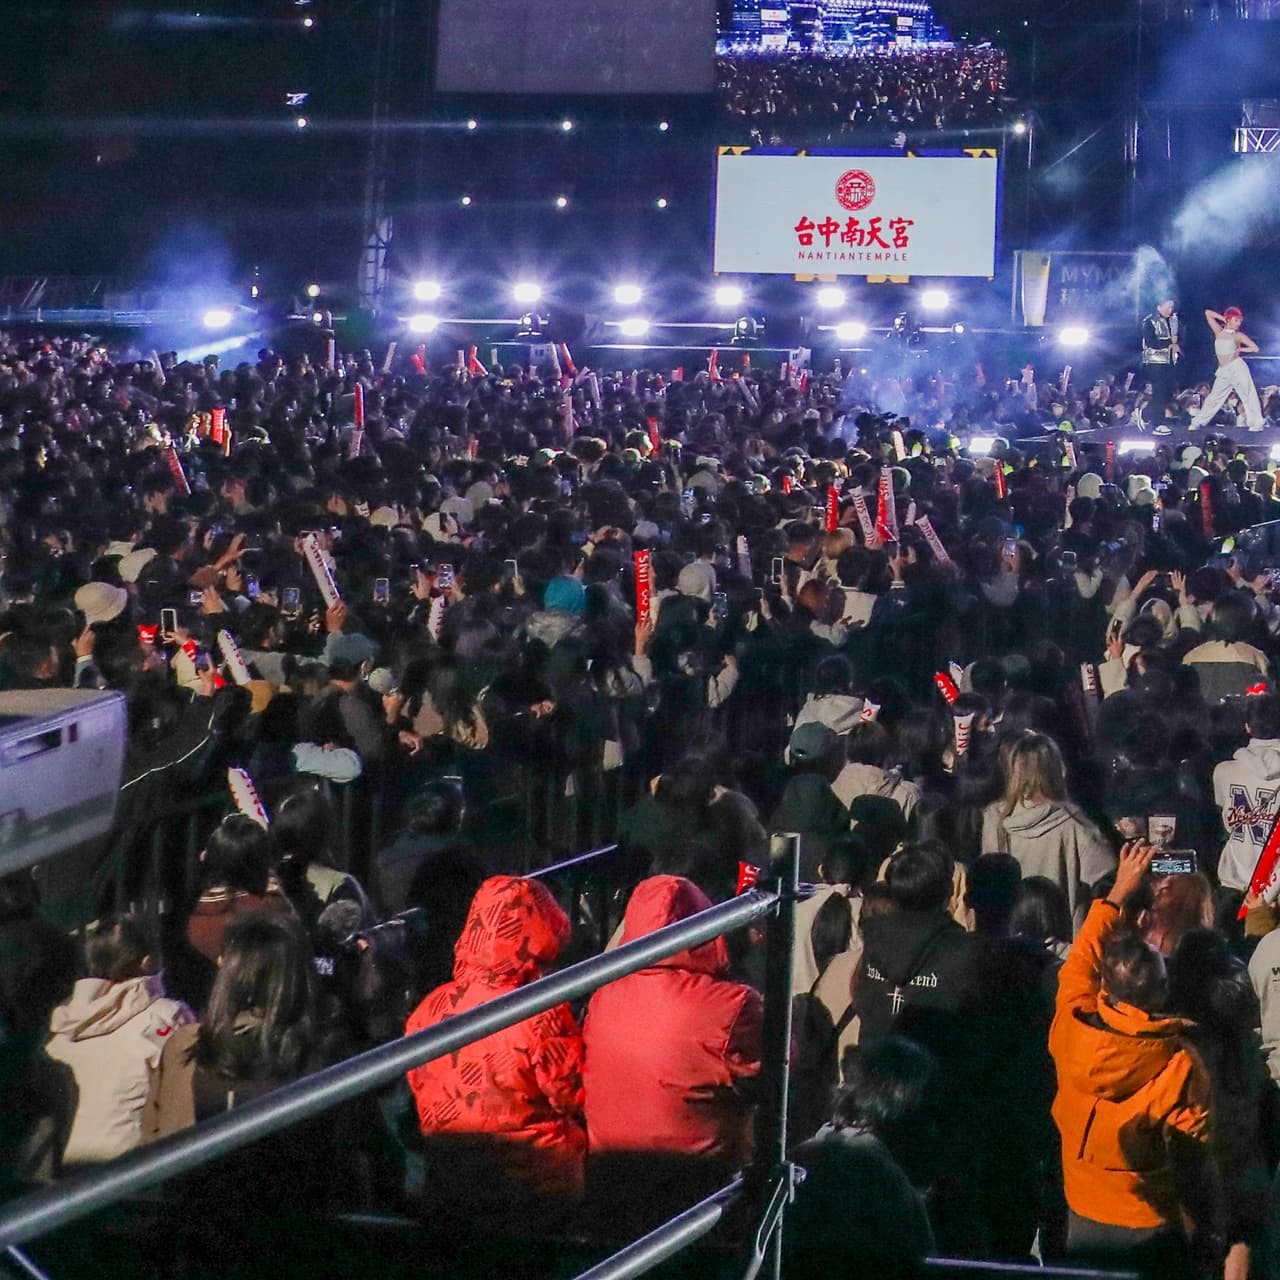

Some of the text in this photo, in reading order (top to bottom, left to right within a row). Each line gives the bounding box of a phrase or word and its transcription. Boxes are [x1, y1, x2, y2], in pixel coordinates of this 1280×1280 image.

[794, 215, 914, 248] 台中南天宮
[798, 251, 908, 261] NANTIANTEMPLE
